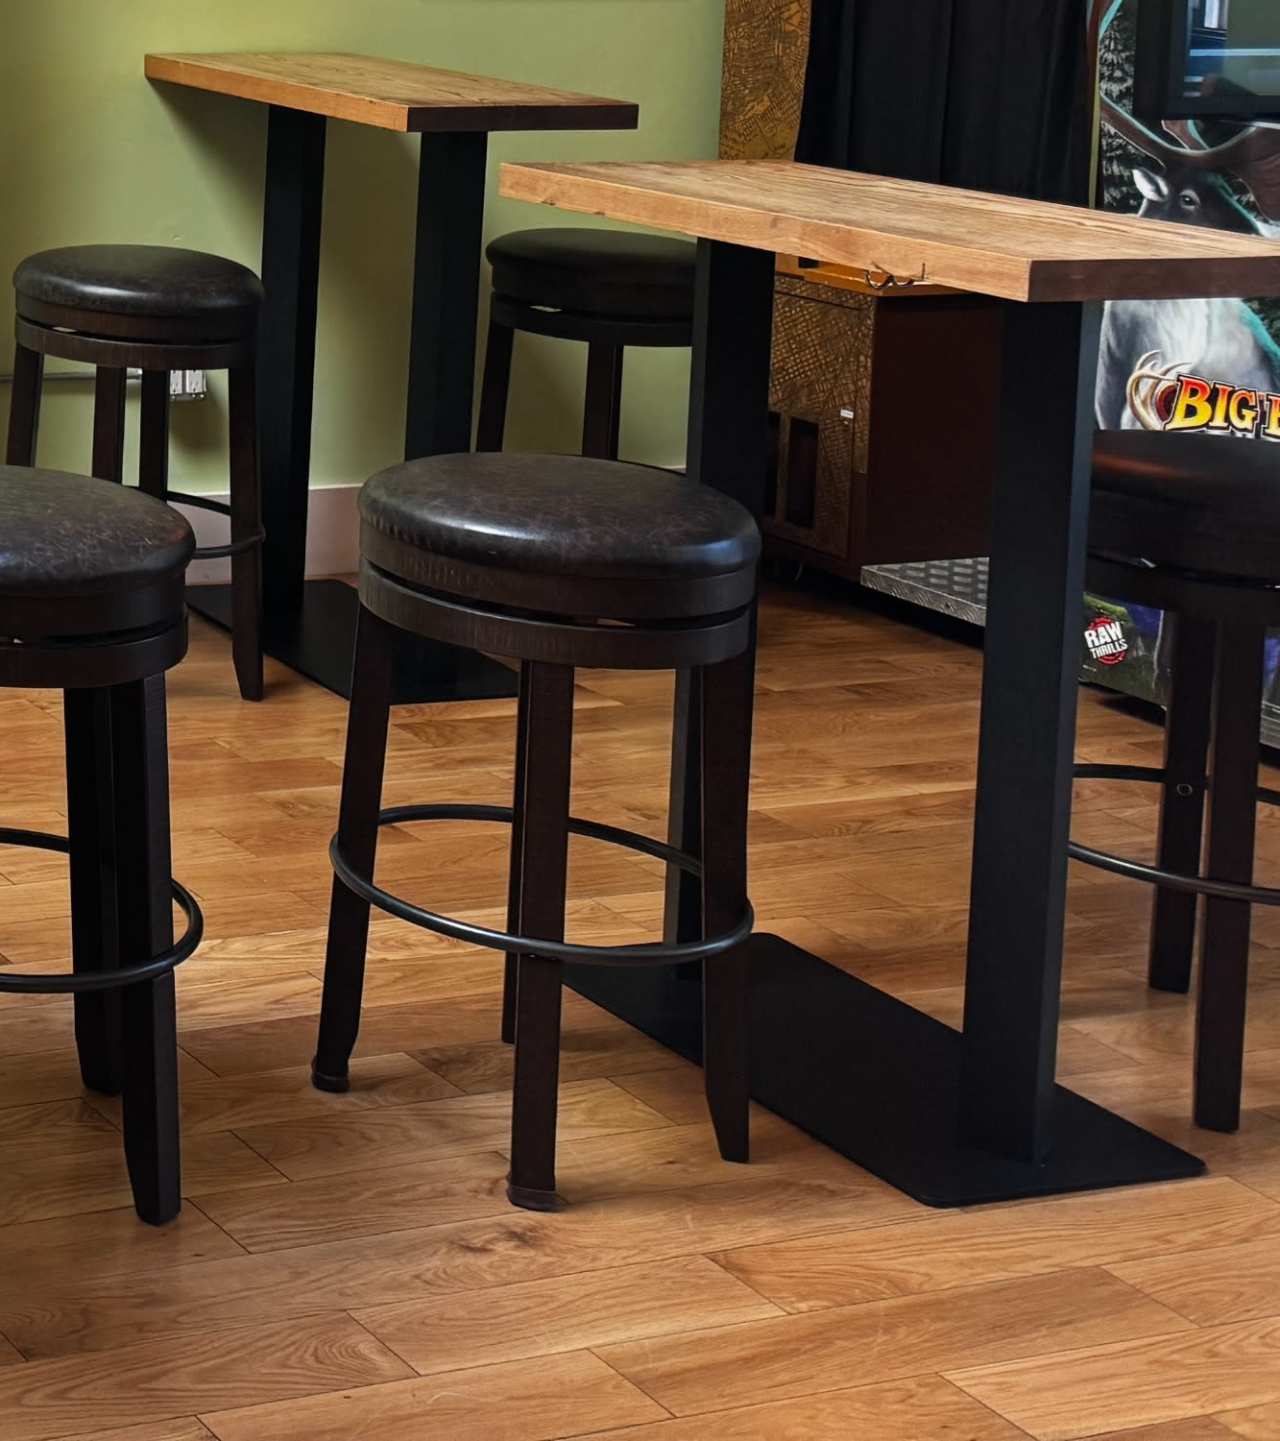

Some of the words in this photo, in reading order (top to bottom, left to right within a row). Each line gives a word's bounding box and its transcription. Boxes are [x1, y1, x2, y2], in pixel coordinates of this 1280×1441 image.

[1164, 373, 1259, 433] BIG
[1084, 621, 1123, 649] RAW
[1089, 638, 1129, 660] THRILLS
